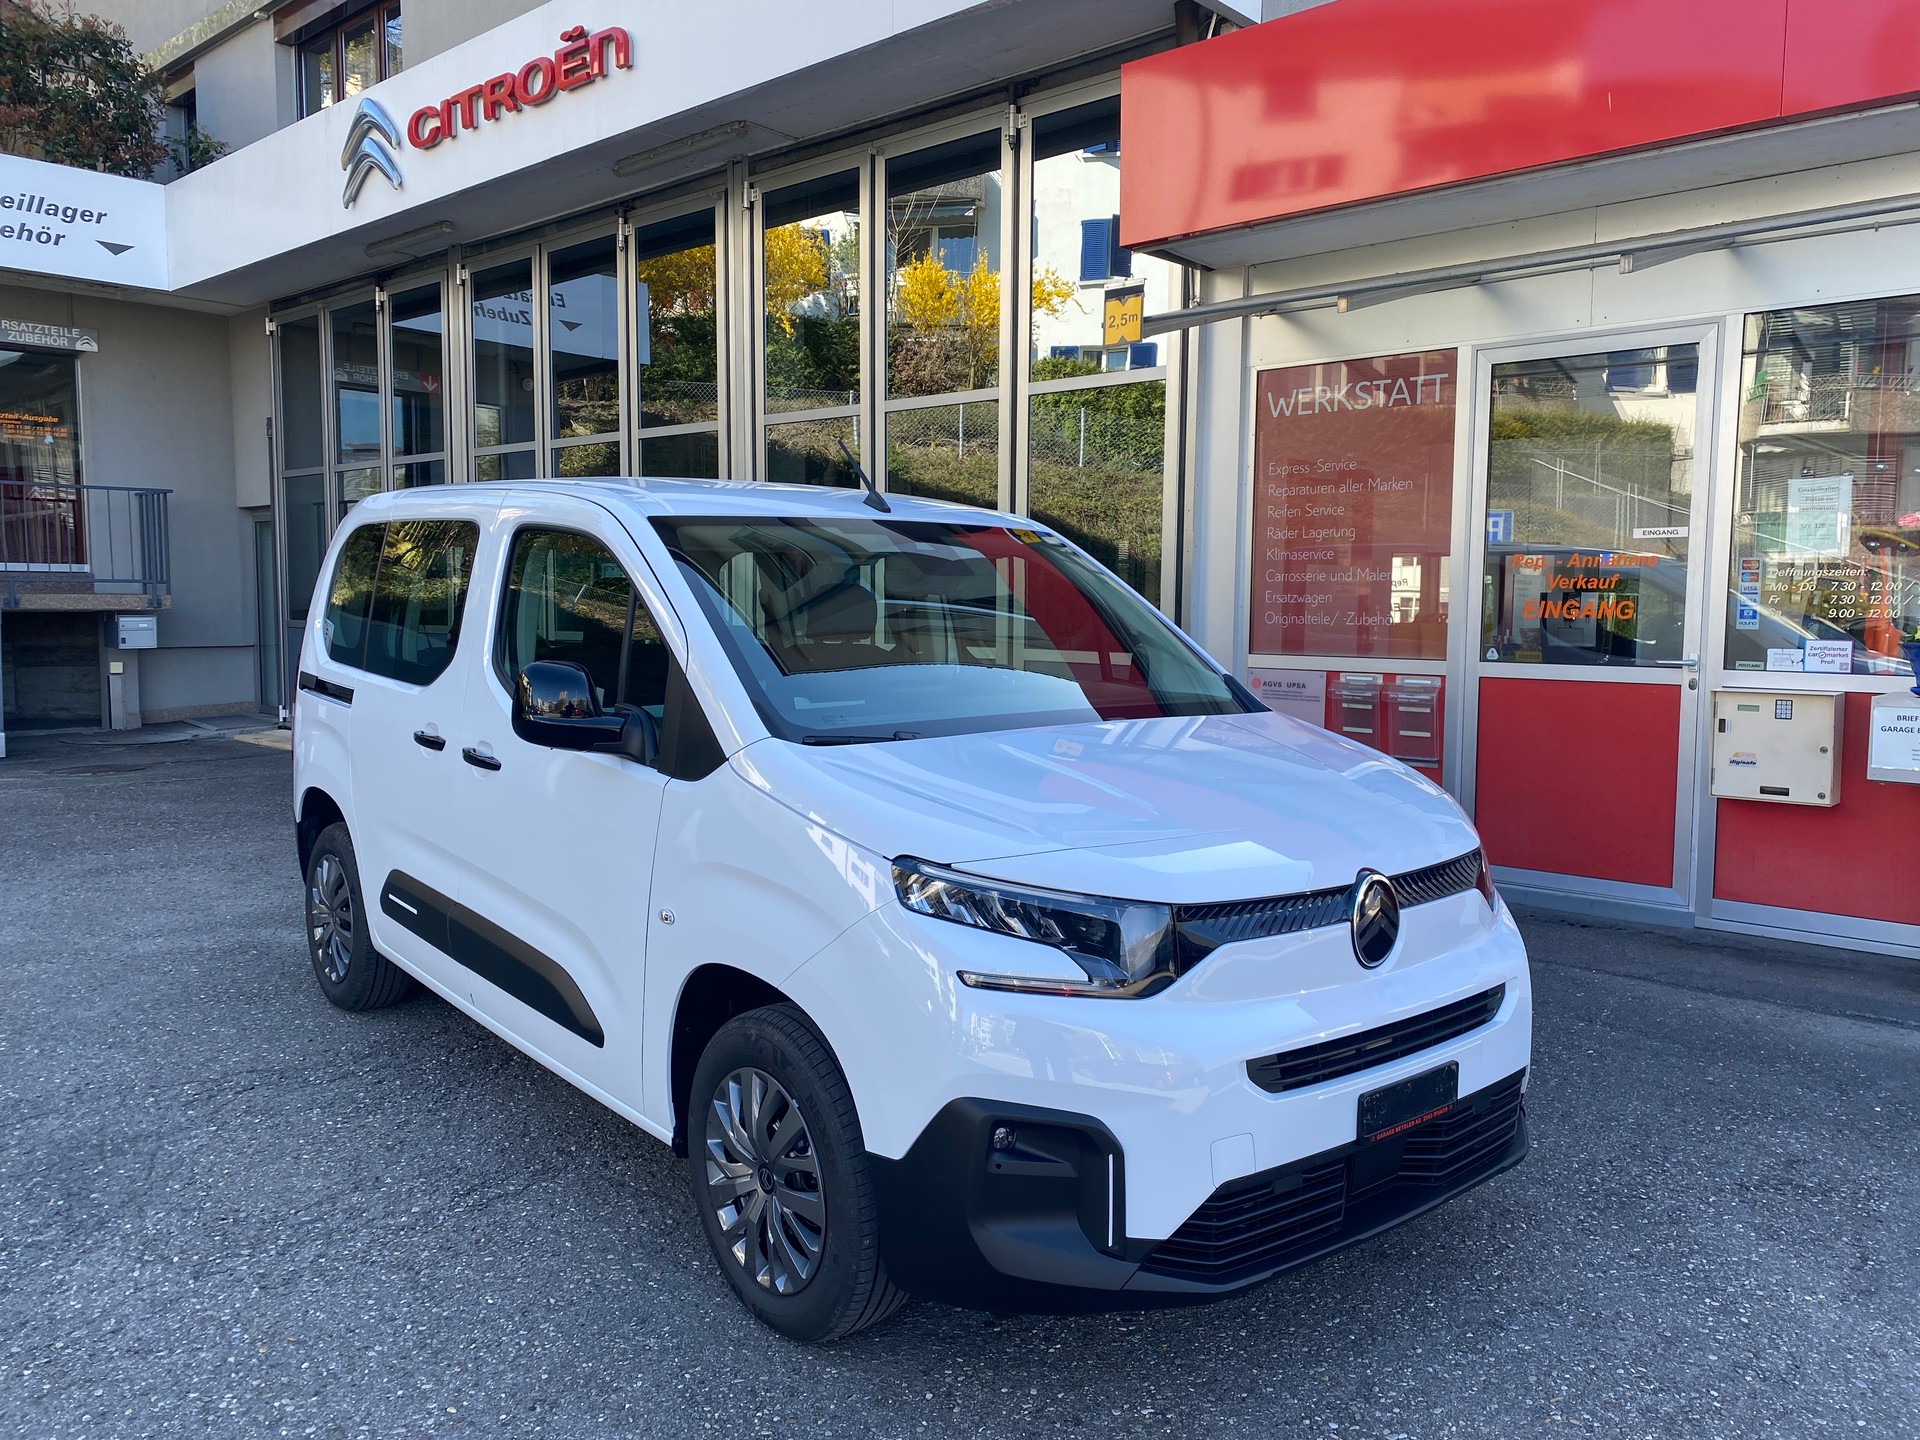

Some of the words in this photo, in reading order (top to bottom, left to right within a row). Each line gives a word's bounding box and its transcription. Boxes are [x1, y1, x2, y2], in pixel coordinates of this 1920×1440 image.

[0, 320, 80, 338] RSATZTEILE
[1108, 313, 1138, 330] 2,5m
[1267, 373, 1449, 418] WERKSTATT
[0, 412, 59, 423] zteil-Ausgabe
[1268, 462, 1310, 478] Express
[1268, 484, 1335, 499] Reparaturen
[1339, 478, 1364, 493] aller
[1368, 476, 1413, 491] Marken
[1267, 504, 1301, 518] Reifen
[1305, 503, 1345, 517] Service
[1267, 526, 1299, 540] Räder
[1302, 526, 1356, 542] Lagerung
[1266, 548, 1335, 561] Klimaservice
[1566, 552, 1660, 568] Annahme
[1265, 569, 1326, 582] Carrosserie
[1330, 568, 1352, 582] und
[1547, 573, 1620, 590] Verkauf
[1769, 582, 1788, 591] Mo
[1799, 582, 1816, 591] Do
[1870, 581, 1903, 591] 12.00
[1265, 590, 1333, 607] Ersatzwagen
[1768, 595, 1781, 604] Fr
[1869, 595, 1901, 605] 12.00
[1522, 600, 1635, 620] EINGANG
[1828, 608, 1855, 618] 9.00
[1868, 609, 1901, 618] 12.00
[1264, 610, 1340, 628] Originalteile/
[1262, 680, 1283, 688] AGVS
[1880, 725, 1915, 734] GARAGE
